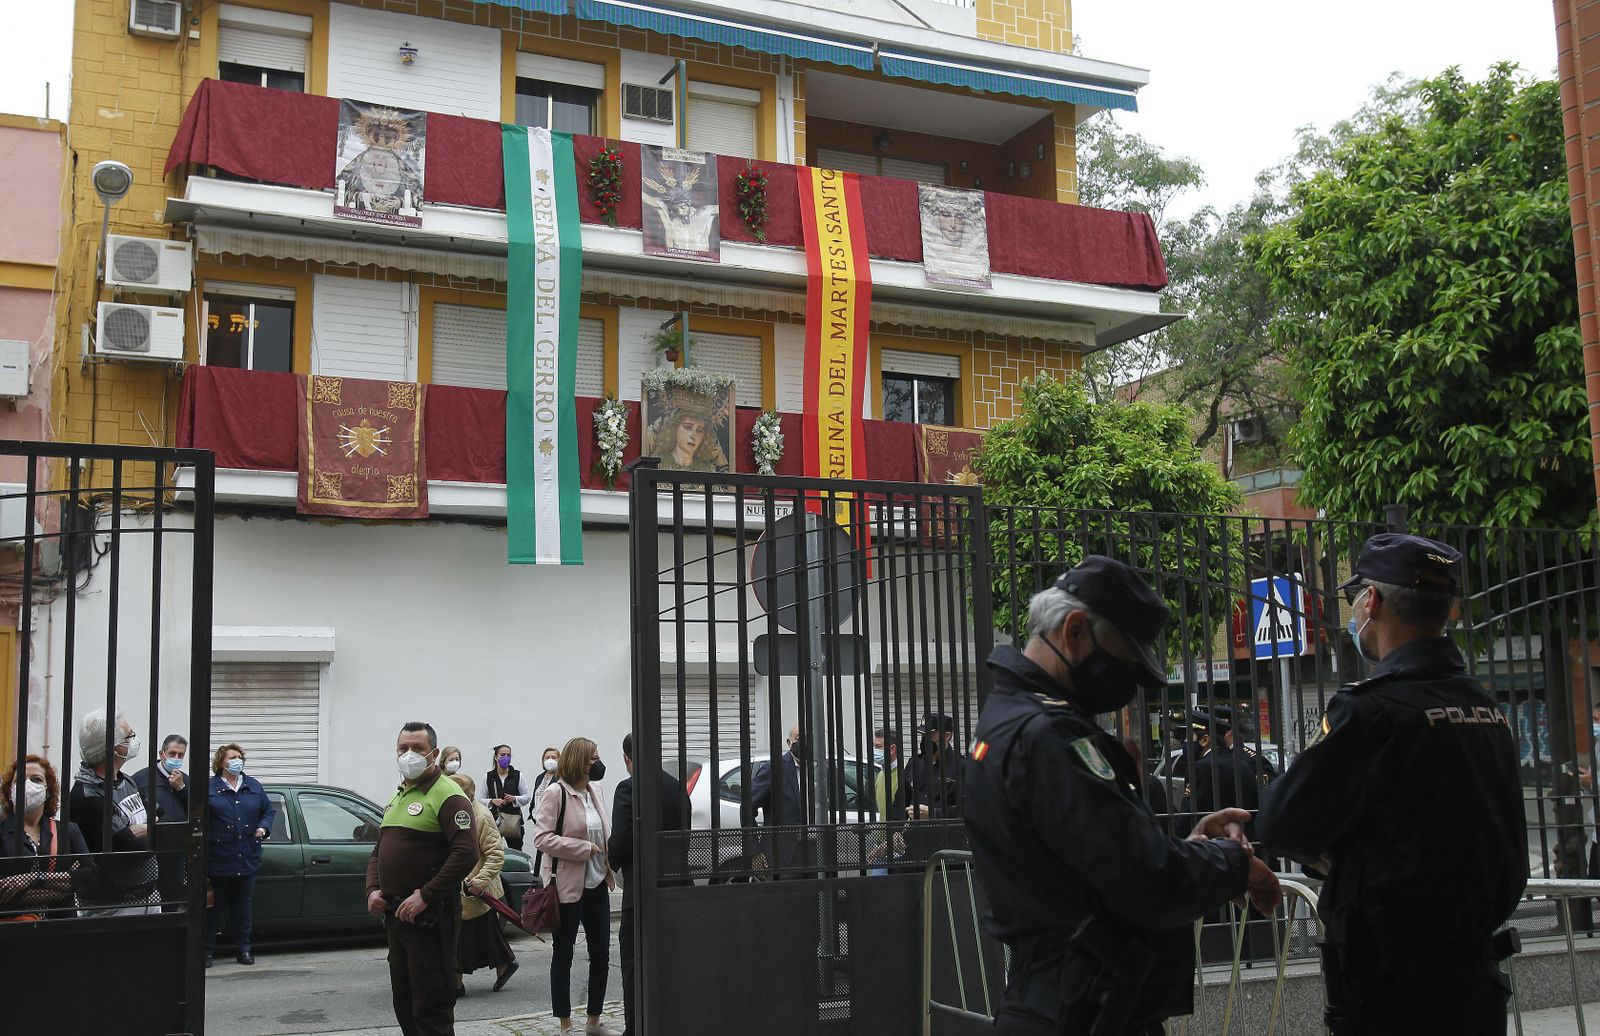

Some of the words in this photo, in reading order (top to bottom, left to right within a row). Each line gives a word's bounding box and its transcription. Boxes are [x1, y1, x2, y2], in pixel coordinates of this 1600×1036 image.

[534, 194, 556, 265] REINA
[820, 168, 843, 235] SANTO
[536, 278, 556, 325] DEL
[829, 246, 849, 341] MARTES
[535, 339, 555, 424] CERRO
[828, 353, 847, 397] DEL
[357, 404, 368, 415] de
[369, 408, 398, 424] nuestra
[828, 410, 846, 479] REINA
[746, 505, 794, 517] NUETR
[1424, 706, 1505, 727] POLICIA
